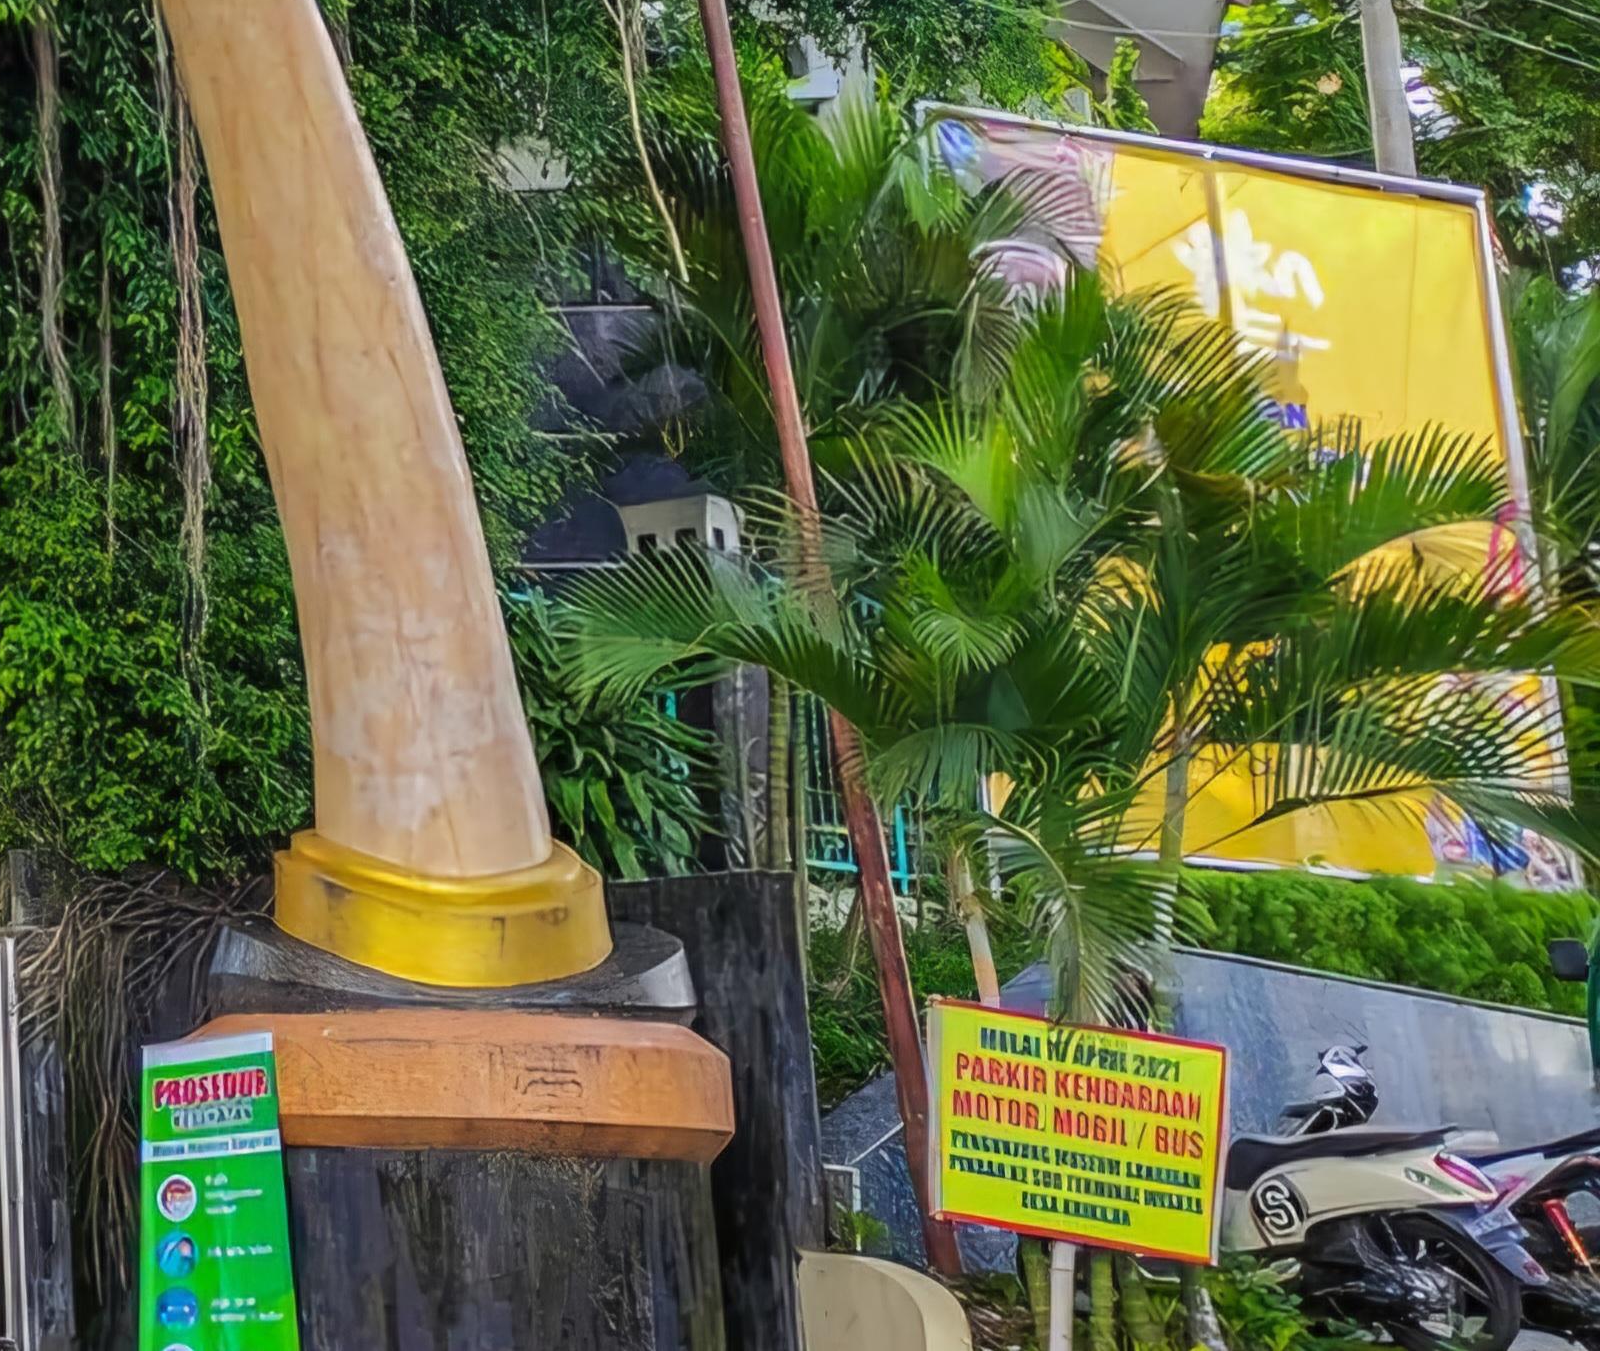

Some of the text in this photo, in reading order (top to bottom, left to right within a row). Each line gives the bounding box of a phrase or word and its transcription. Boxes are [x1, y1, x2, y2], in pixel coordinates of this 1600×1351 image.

[154, 1067, 269, 1109] PROSEDUR
[956, 1052, 1202, 1123] PARKIR KENDARAAN
[1053, 1105, 1128, 1147] MOBIL
[1154, 1124, 1205, 1160] BUS
